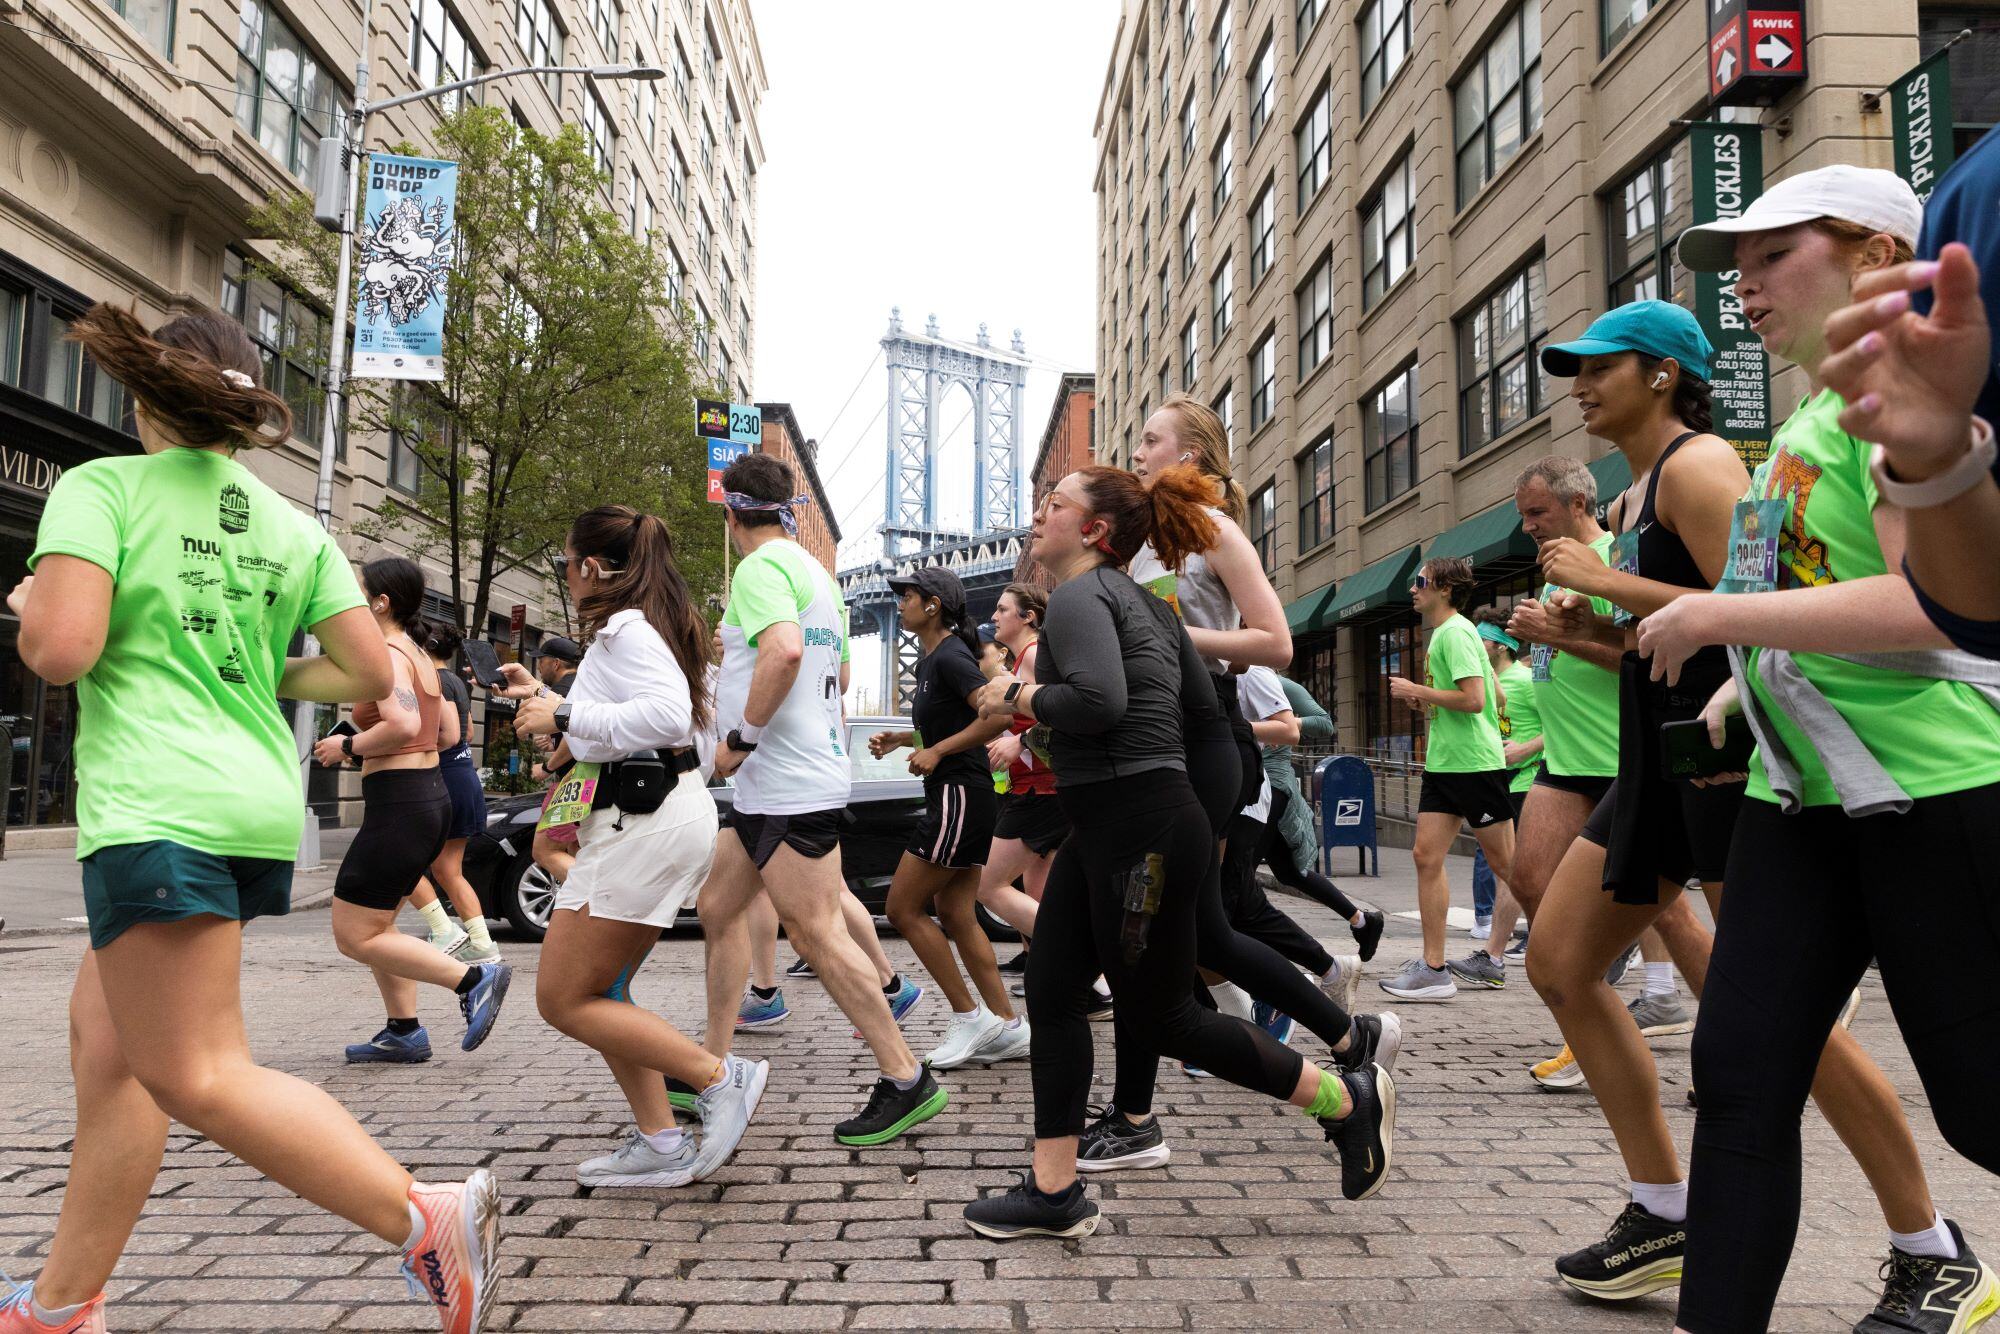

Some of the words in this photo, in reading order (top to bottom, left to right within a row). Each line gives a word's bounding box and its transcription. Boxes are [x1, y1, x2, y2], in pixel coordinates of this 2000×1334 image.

[1752, 19, 1794, 28] KWIK
[1712, 25, 1737, 53] KWIK
[1906, 72, 1934, 188] PICKLES
[373, 162, 440, 179] DUMBO
[1713, 133, 1742, 222] ICKLES
[372, 177, 422, 193] DROP
[361, 334, 372, 342] 31
[1736, 341, 1762, 351] SUSHI
[1720, 351, 1738, 360] HOT
[1740, 352, 1763, 361] FOOD
[1715, 360, 1738, 370] COLD
[1740, 361, 1763, 371] FOOD
[1735, 371, 1764, 380] SALAD
[1708, 379, 1732, 389] RESH
[1733, 381, 1764, 390] FRUITS
[1723, 400, 1765, 410] FLOWERS
[1736, 409, 1757, 419] DELI
[1758, 410, 1765, 419] &
[731, 412, 760, 436] 2:30
[1725, 419, 1766, 429] GROCERY
[182, 570, 197, 579] RUN
[200, 578, 216, 587] ONE
[223, 593, 242, 602] Health
[734, 1062, 743, 1088] HOKA
[1603, 1250, 1630, 1269] new
[1628, 1231, 1686, 1258] balance
[421, 1250, 449, 1307] HOKA
